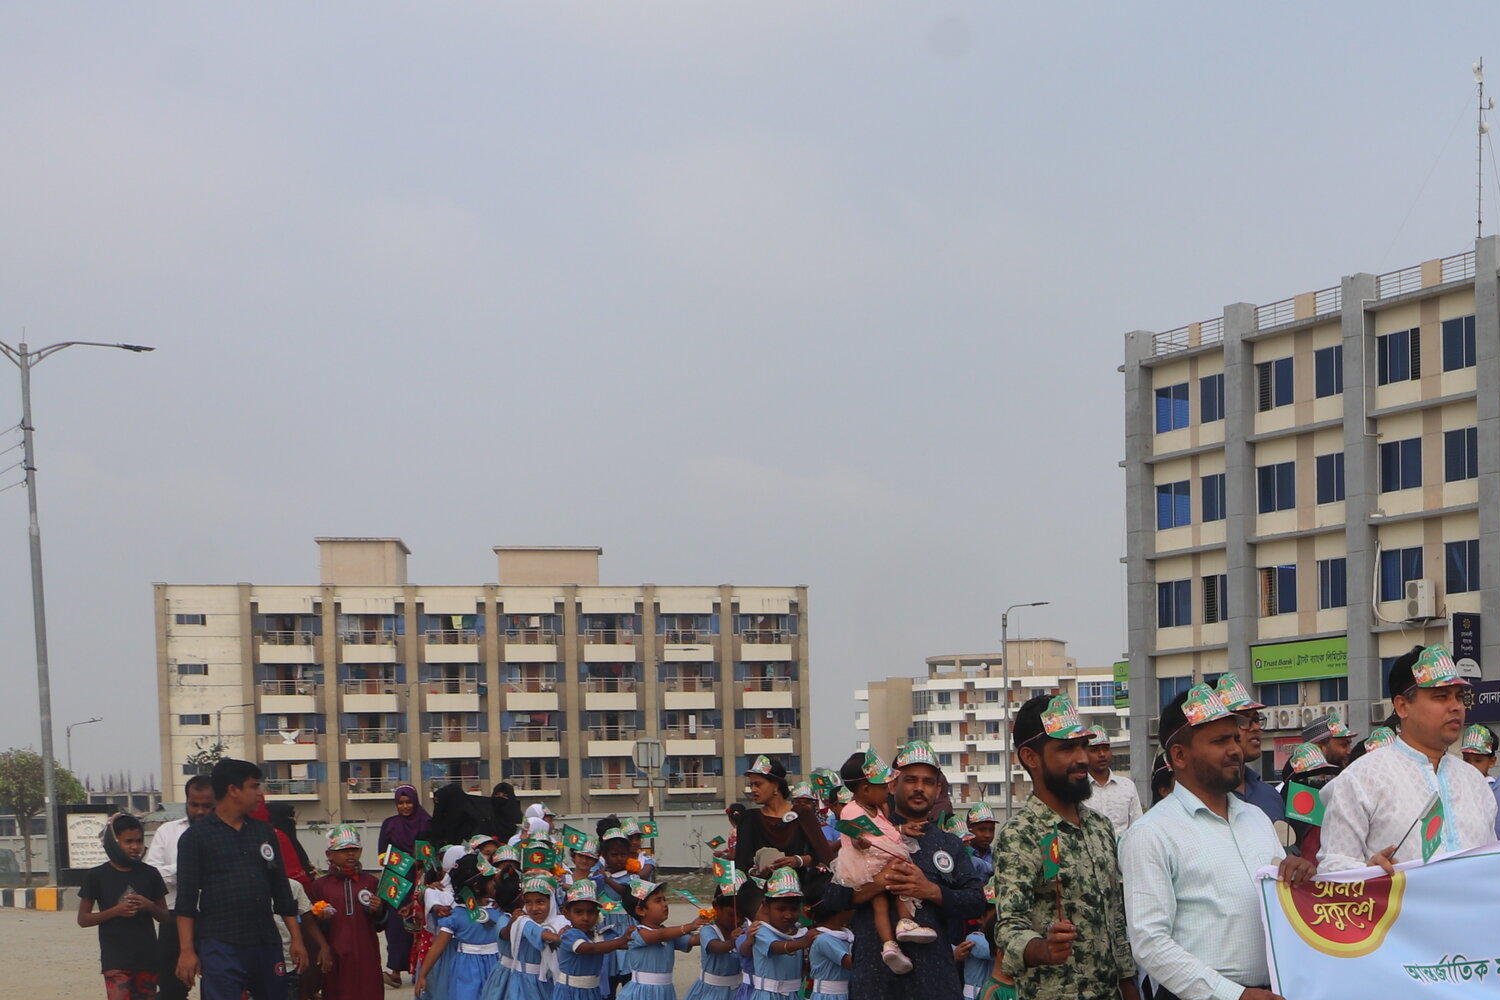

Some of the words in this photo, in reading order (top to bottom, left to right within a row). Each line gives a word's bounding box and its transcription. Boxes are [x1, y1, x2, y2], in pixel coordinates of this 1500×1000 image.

[1278, 658, 1292, 666] Bank
[1310, 898, 1377, 930] একুশে
[1402, 954, 1490, 985] আন্তর্জাতিক
